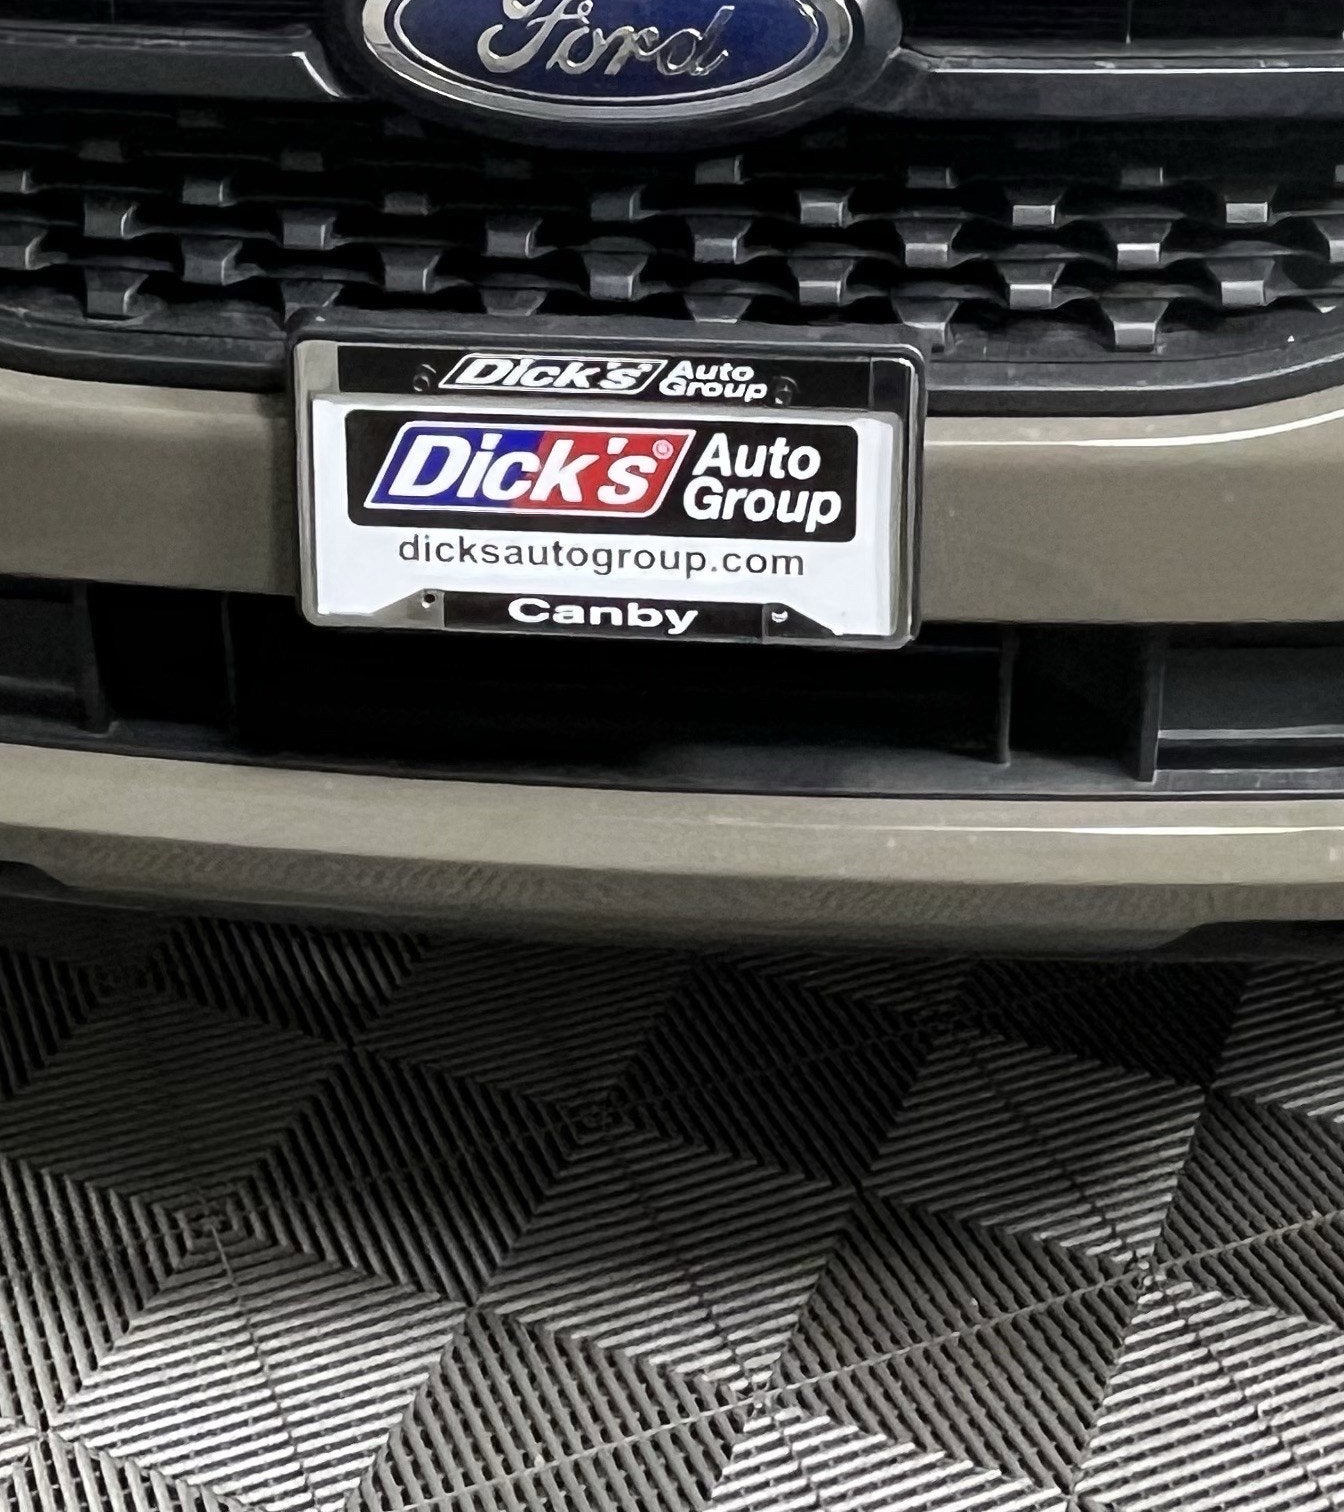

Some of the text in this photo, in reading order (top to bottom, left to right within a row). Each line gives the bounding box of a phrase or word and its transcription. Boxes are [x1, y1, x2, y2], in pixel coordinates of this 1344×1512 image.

[456, 358, 653, 390] Dick's
[659, 378, 768, 402] Group
[670, 360, 755, 382] Auto
[693, 433, 822, 480] Auto
[683, 477, 842, 533] Group
[398, 534, 805, 579] dicksautogroup.com
[508, 597, 698, 635] Canby
